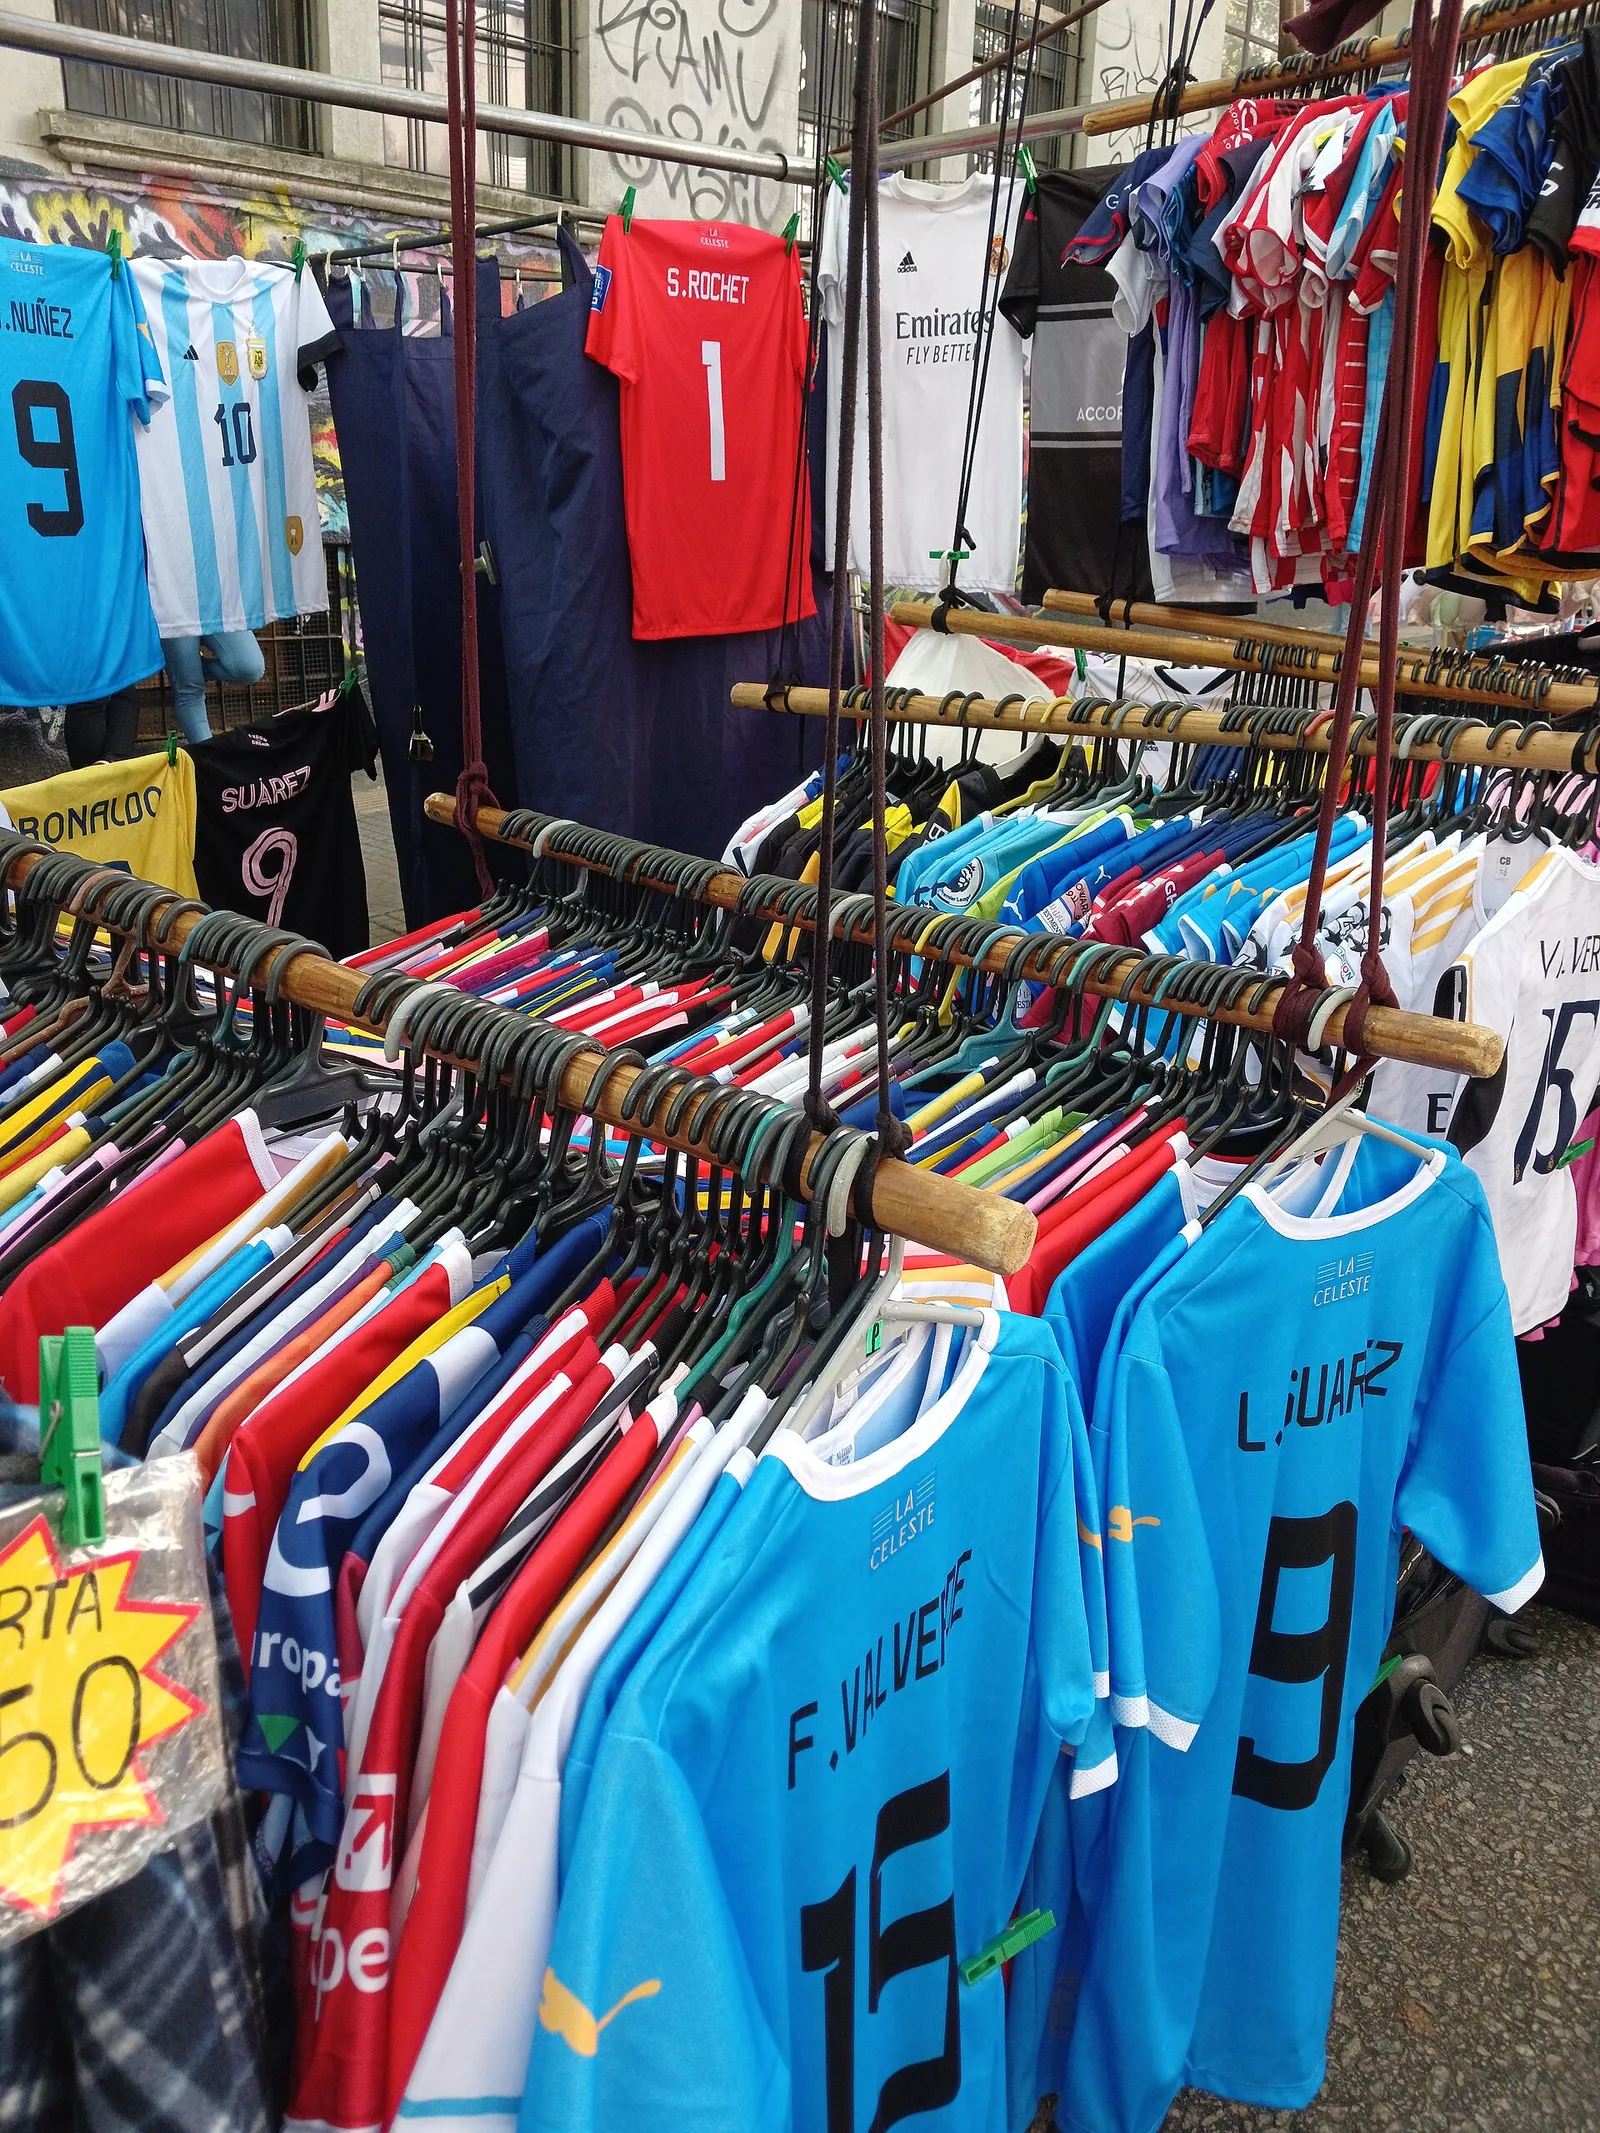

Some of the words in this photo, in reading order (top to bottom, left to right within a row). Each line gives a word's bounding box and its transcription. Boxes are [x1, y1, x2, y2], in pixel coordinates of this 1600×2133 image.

[20, 251, 32, 262] LA
[700, 237, 730, 249] CELESTE
[10, 261, 45, 276] CELESTE
[667, 267, 750, 304] S.ROCHET
[897, 266, 918, 274] adidas
[0, 296, 74, 339] .NUÑEZ
[906, 346, 931, 366] FLY
[701, 340, 726, 481] 1
[213, 402, 257, 467] 10
[11, 379, 85, 538] 9
[221, 765, 312, 813] SUÁREZ
[18, 785, 162, 845] RONALDO
[241, 827, 298, 927] 9
[1499, 856, 1512, 866] CB
[1513, 1000, 1600, 1186] 15
[1337, 1256, 1354, 1278] LA
[1313, 1275, 1371, 1307] CELESTE
[896, 1489, 914, 1522] LA
[869, 1501, 935, 1570] CELESTE
[1233, 1501, 1358, 1810] 9
